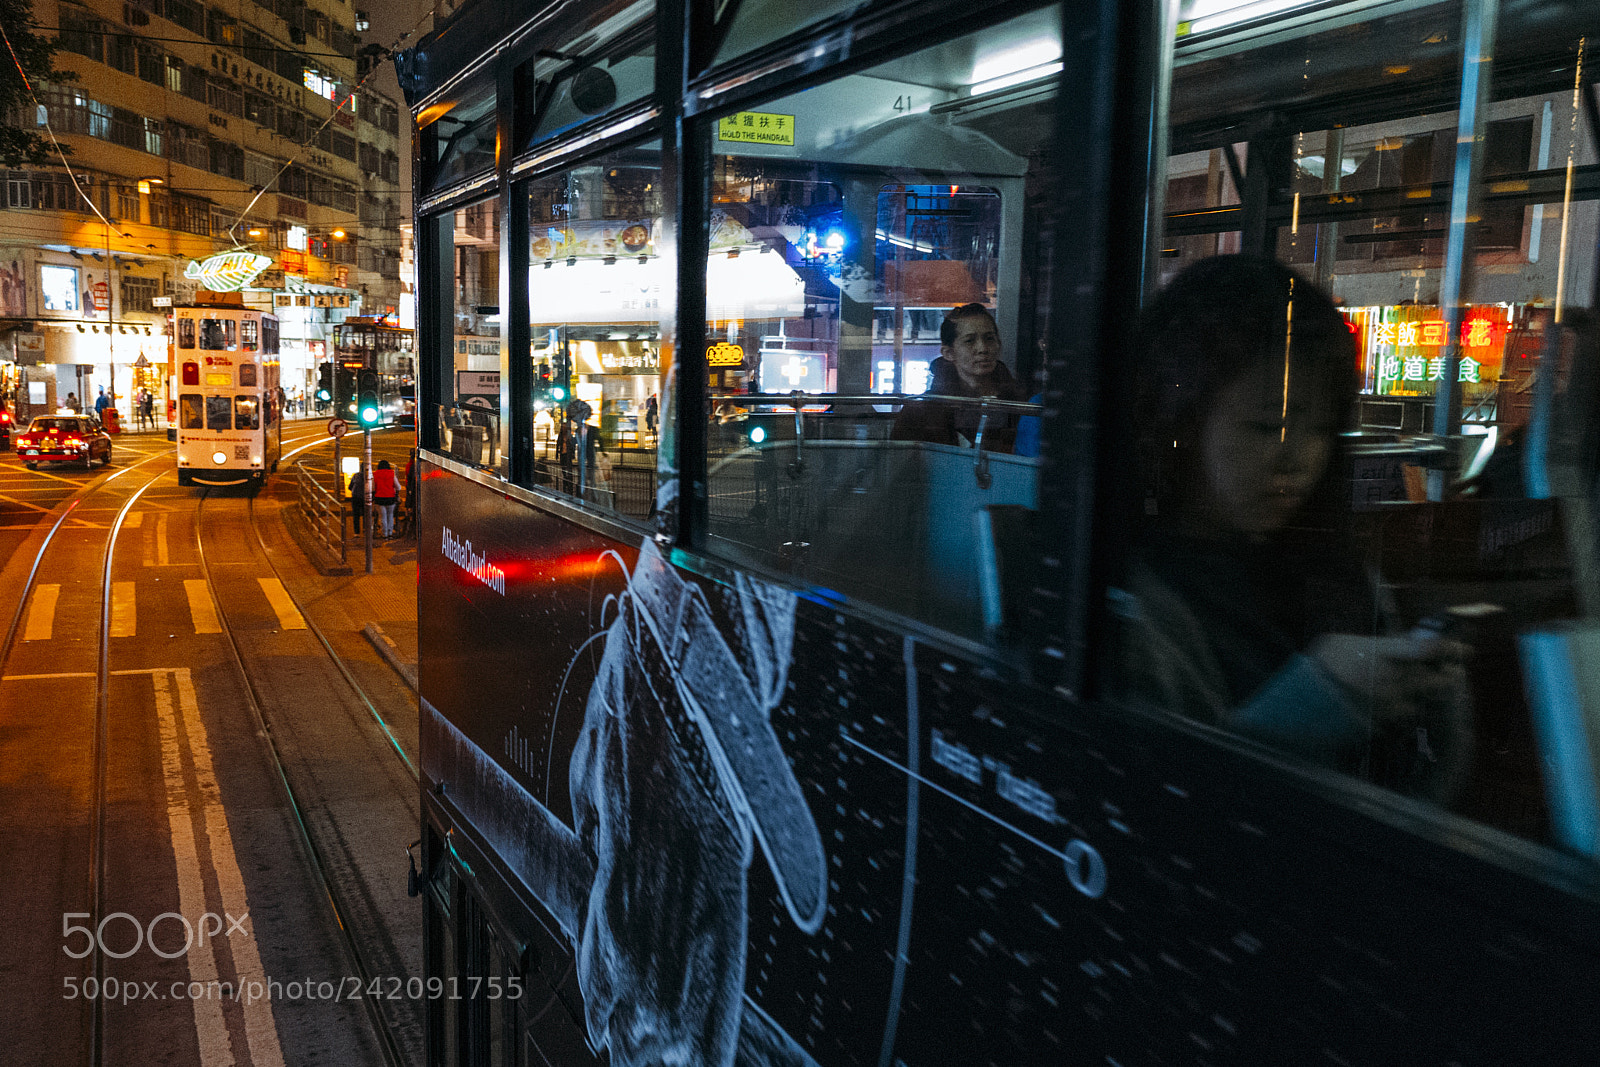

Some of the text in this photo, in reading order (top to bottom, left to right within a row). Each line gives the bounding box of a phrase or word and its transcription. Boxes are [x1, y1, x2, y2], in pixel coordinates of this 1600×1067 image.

[892, 95, 912, 113] 41
[727, 114, 786, 129] 緊握扶手
[722, 130, 791, 143] HOLD THE HANDRAIL
[209, 293, 227, 302] 47
[1381, 356, 1482, 384] 地道美食
[441, 525, 505, 597] AlibabaCloud.com
